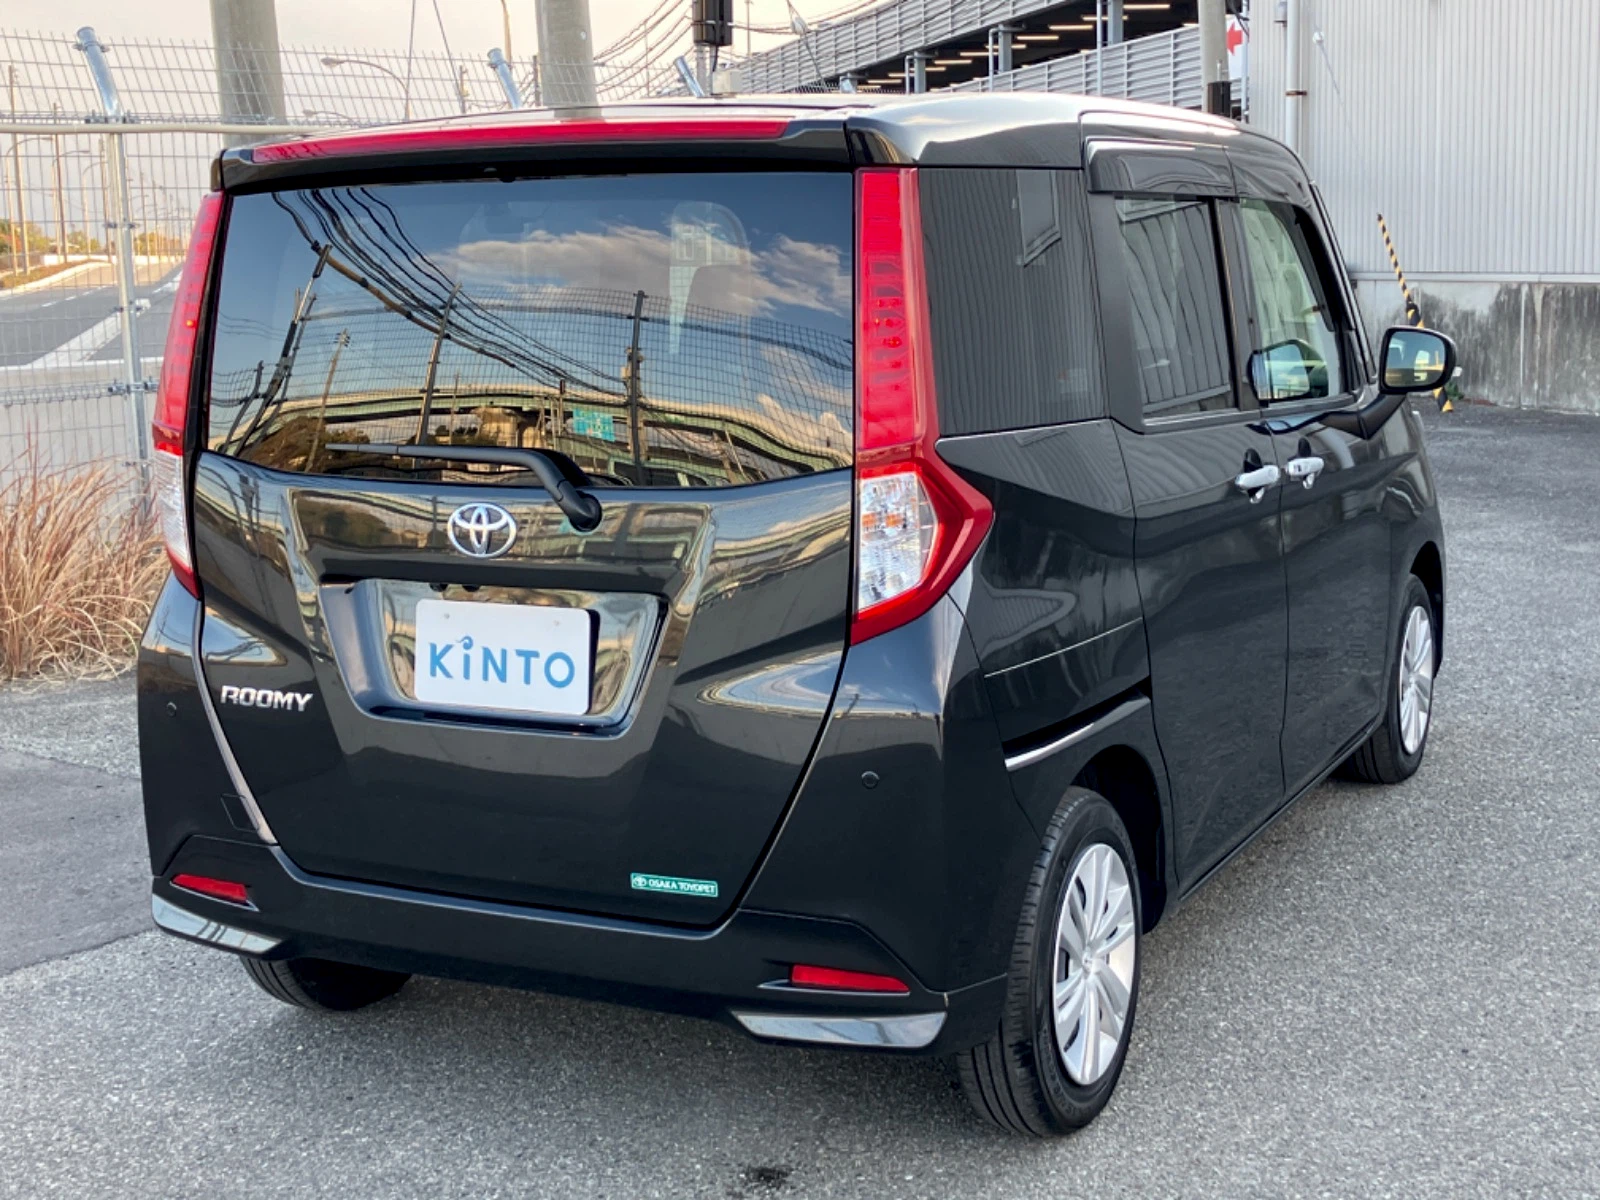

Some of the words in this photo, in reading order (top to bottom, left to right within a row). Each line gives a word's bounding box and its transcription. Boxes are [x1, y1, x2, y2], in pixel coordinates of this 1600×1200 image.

[220, 685, 314, 712] ROOMY
[648, 879, 678, 890] OSAKA
[678, 881, 715, 894] TOYOPET
